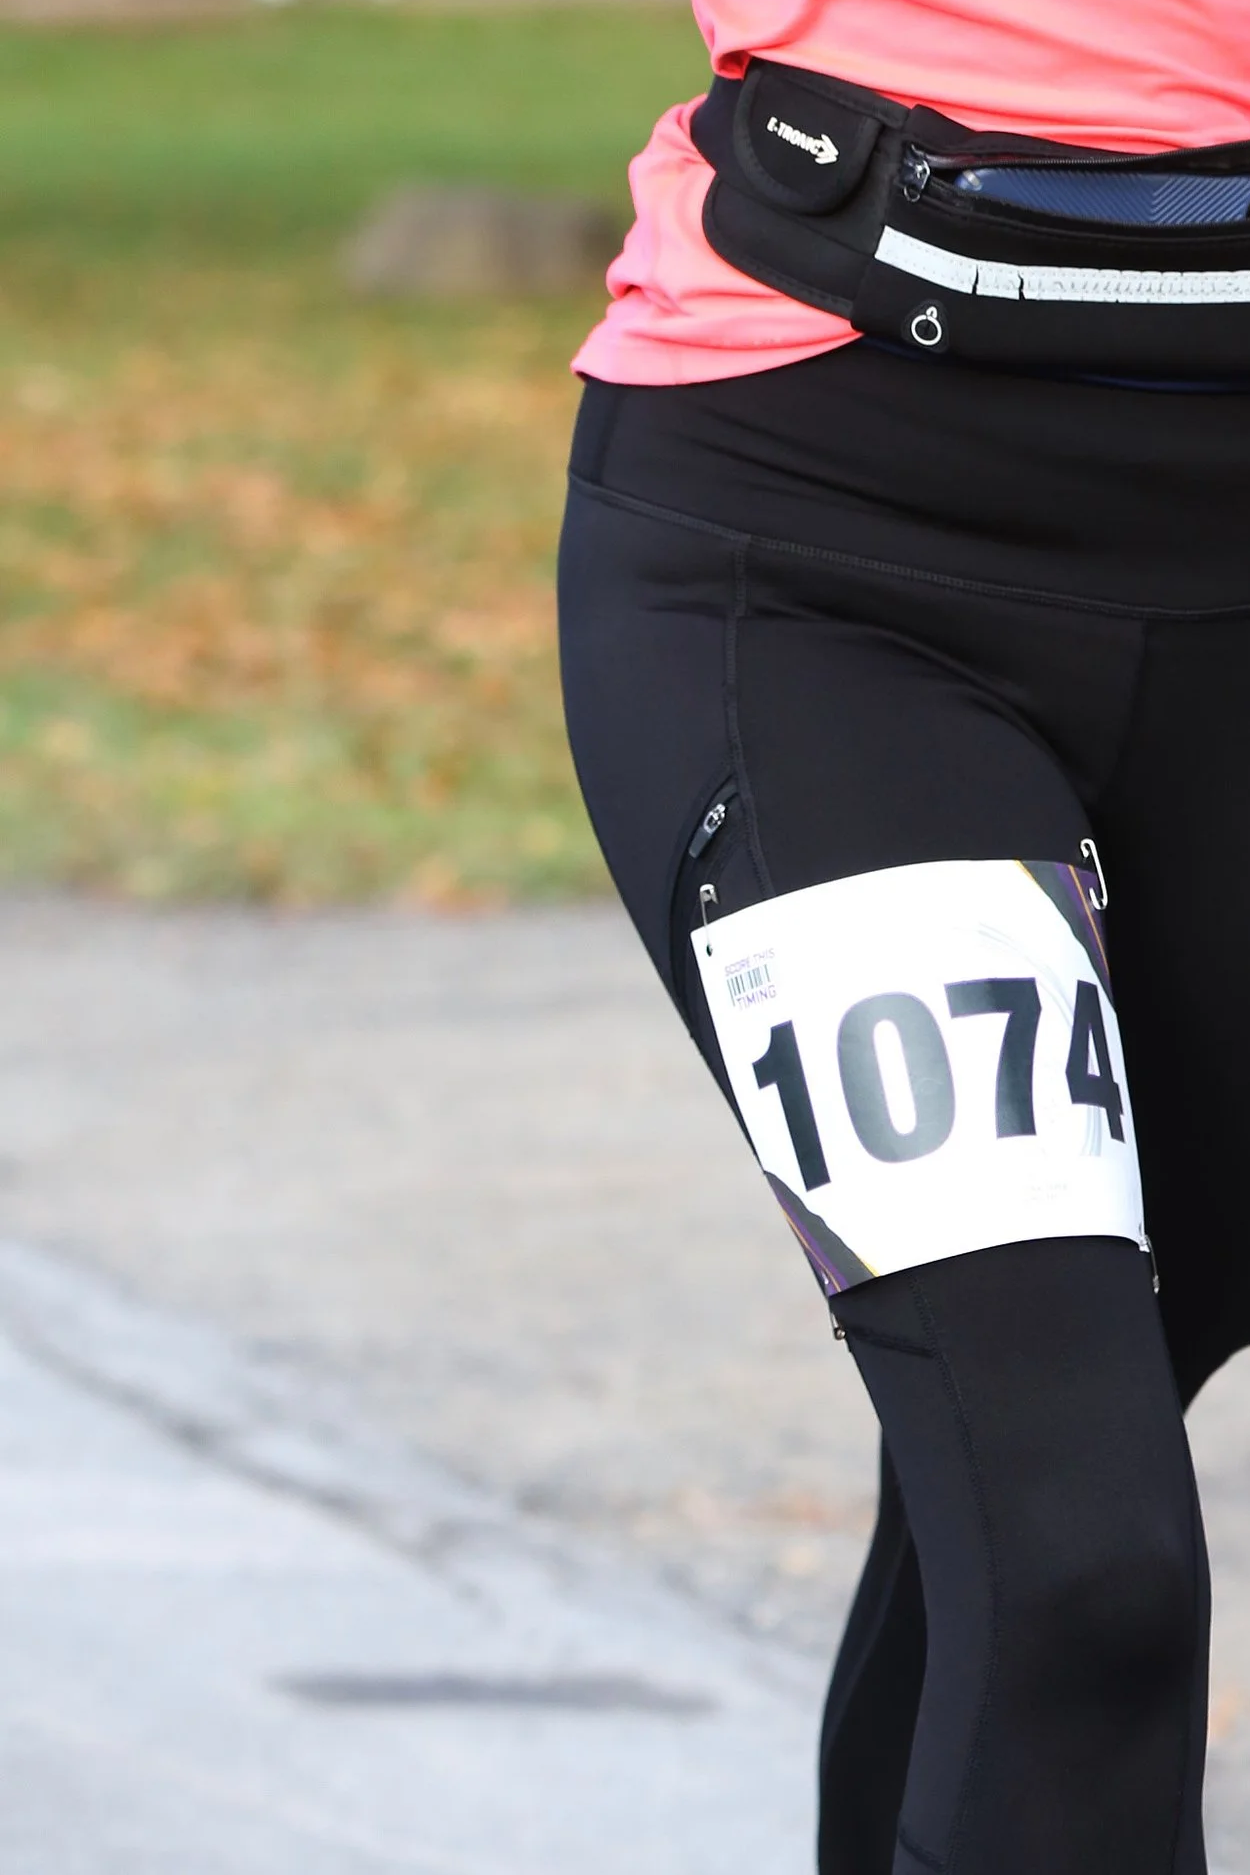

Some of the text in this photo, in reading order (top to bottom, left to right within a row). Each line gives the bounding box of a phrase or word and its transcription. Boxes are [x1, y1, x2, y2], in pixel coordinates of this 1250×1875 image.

[725, 947, 776, 977] SCORE THIS
[736, 984, 777, 1011] TIMING
[752, 977, 1126, 1192] 1074
